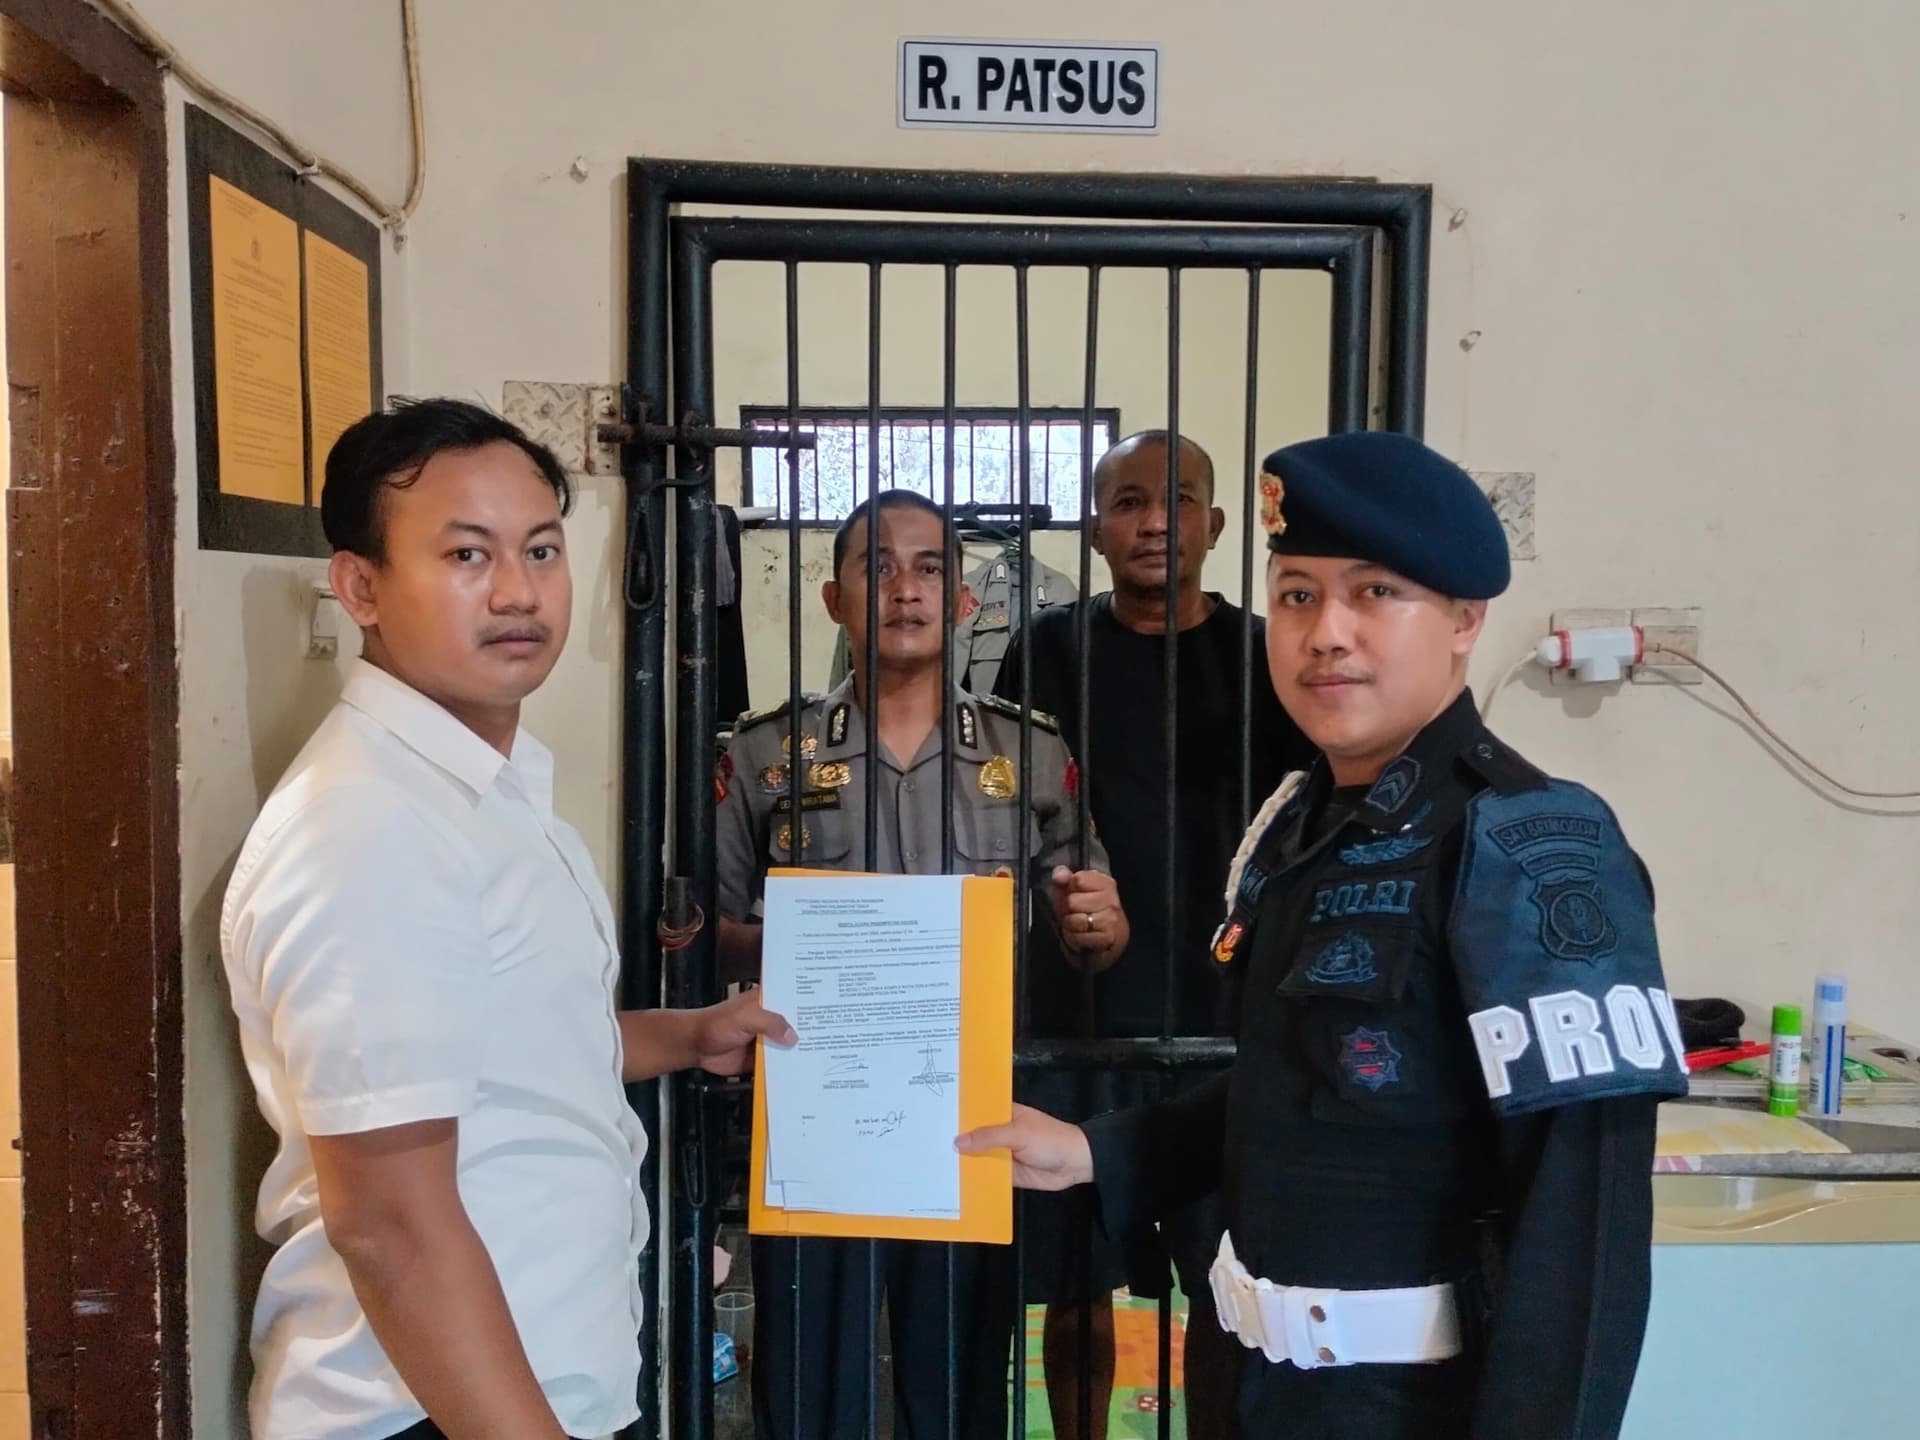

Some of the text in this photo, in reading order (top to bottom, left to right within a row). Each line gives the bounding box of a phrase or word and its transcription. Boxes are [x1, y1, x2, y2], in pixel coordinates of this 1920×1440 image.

[918, 55, 1146, 116] R. PATSUS
[1310, 880, 1417, 922] POLRI
